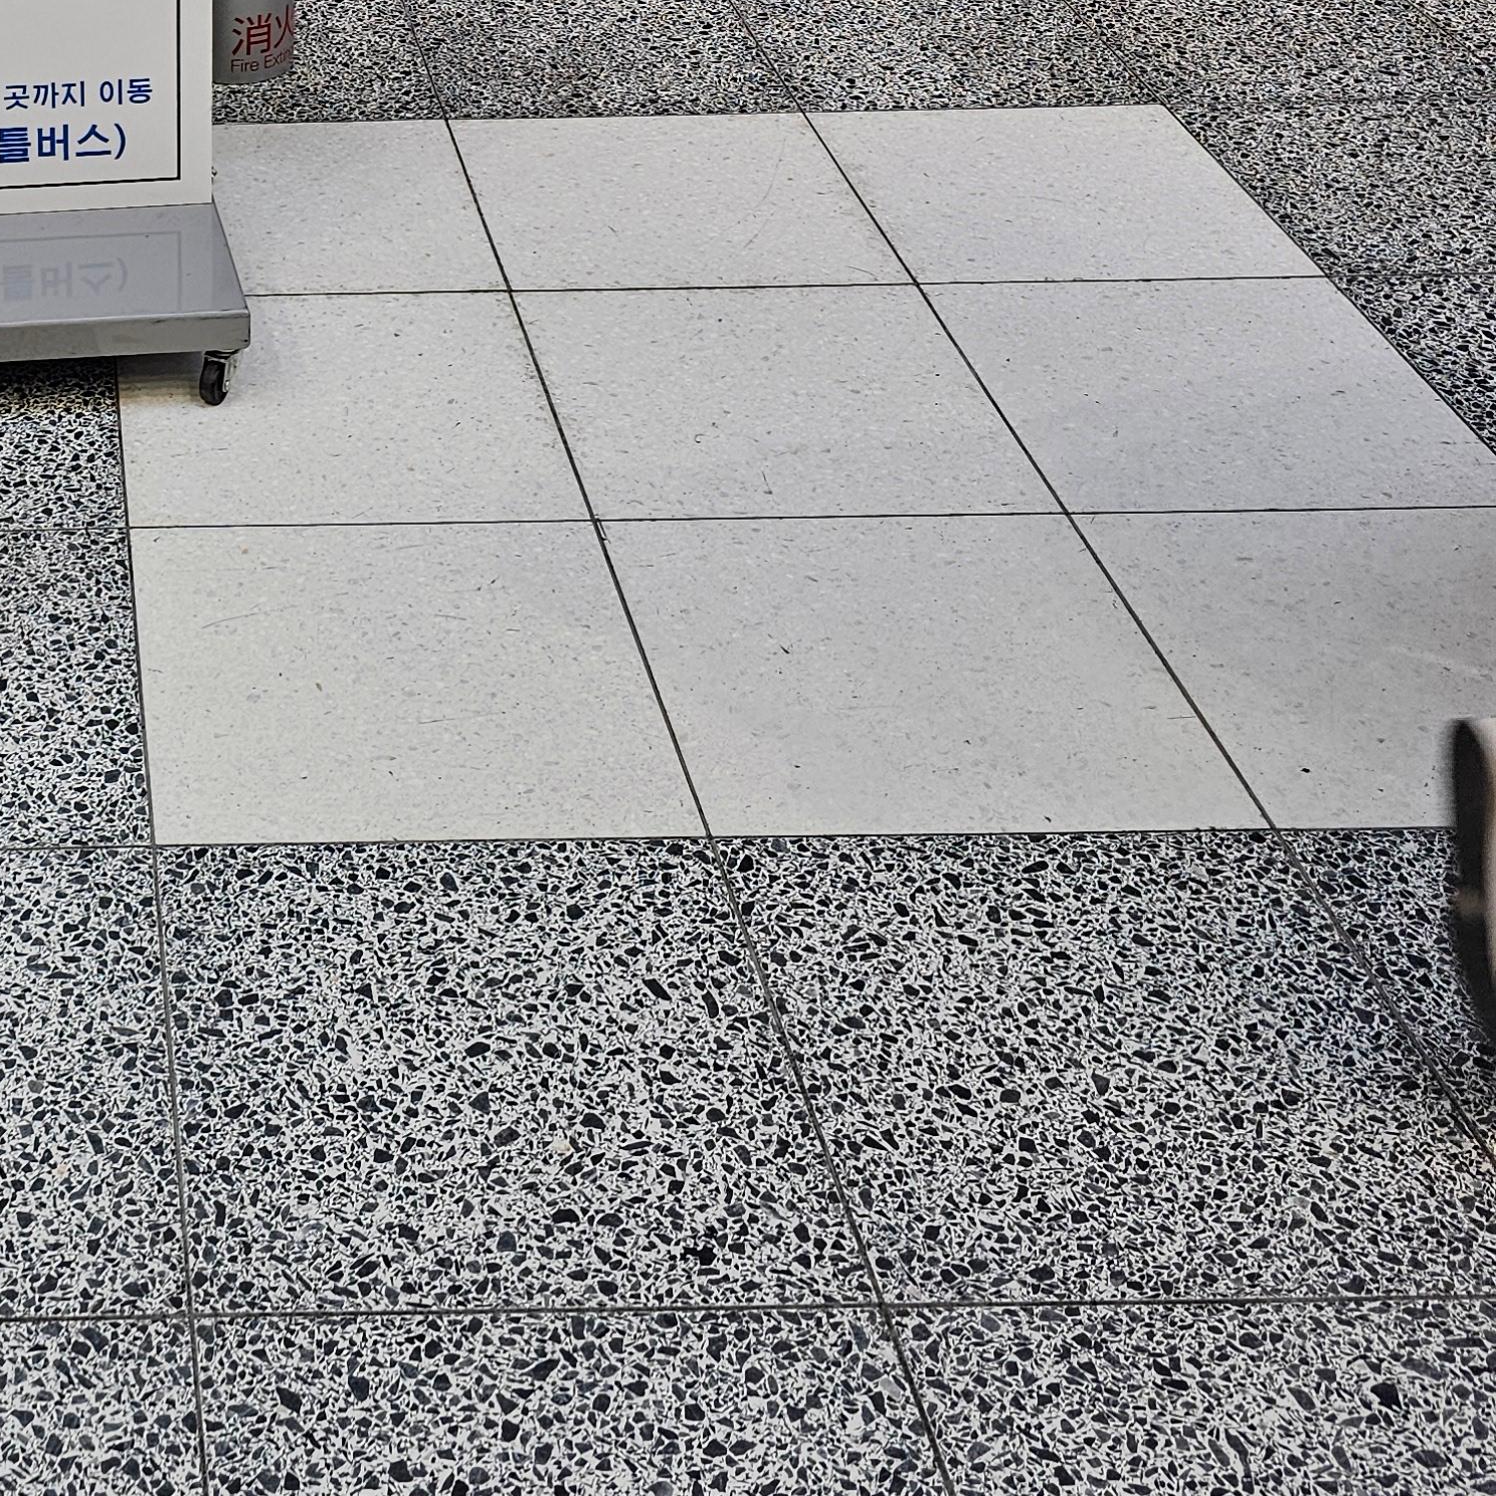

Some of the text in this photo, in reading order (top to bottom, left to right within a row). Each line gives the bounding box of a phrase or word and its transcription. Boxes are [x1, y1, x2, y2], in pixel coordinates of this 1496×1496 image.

[231, 58, 260, 73] Fire
[3, 80, 86, 112] 곳까지
[98, 75, 154, 105] 이동
